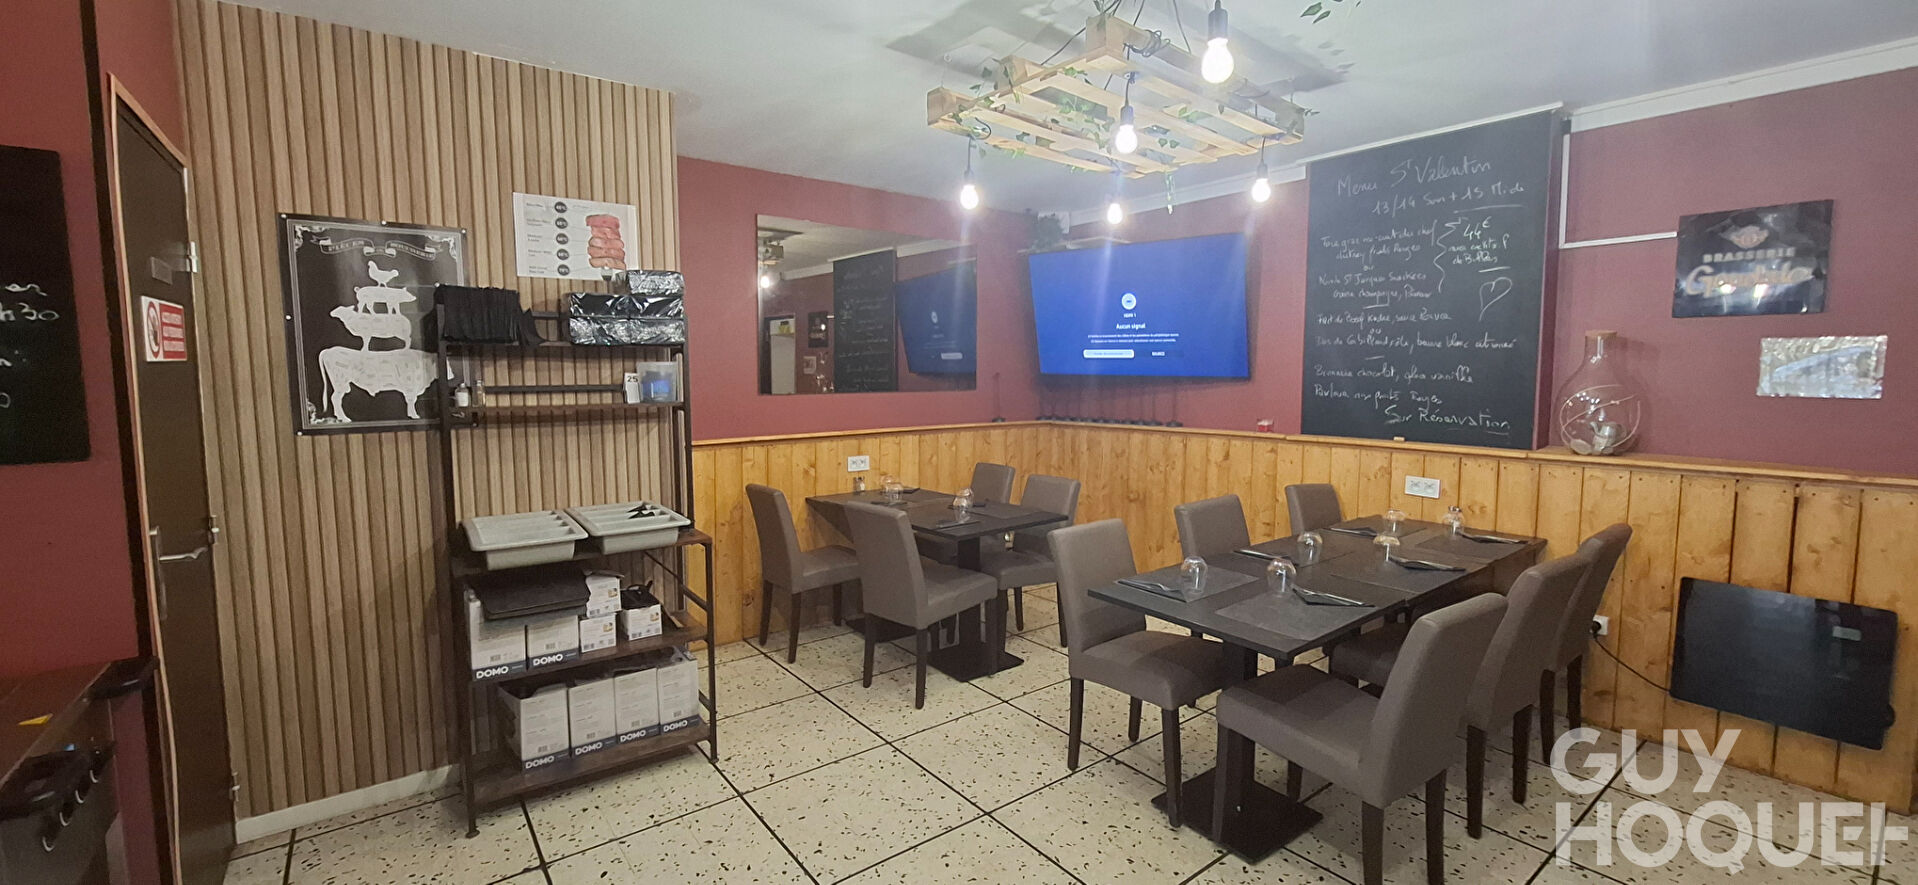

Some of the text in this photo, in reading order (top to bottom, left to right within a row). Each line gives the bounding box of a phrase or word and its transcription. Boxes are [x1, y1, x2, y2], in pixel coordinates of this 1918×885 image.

[1338, 174, 1377, 198] Menu
[1415, 156, 1491, 184] Valentin
[1703, 247, 1796, 264] BRASSERIE
[1131, 322, 1146, 331] signal
[626, 375, 639, 384] 25
[1384, 405, 1511, 430] Sur Réservation
[533, 653, 564, 667] DOMO
[476, 665, 509, 680] DOMO
[663, 720, 689, 732] DOMO
[620, 730, 647, 742] DOMO
[575, 742, 603, 755] DOMO
[525, 755, 555, 769] DOMO
